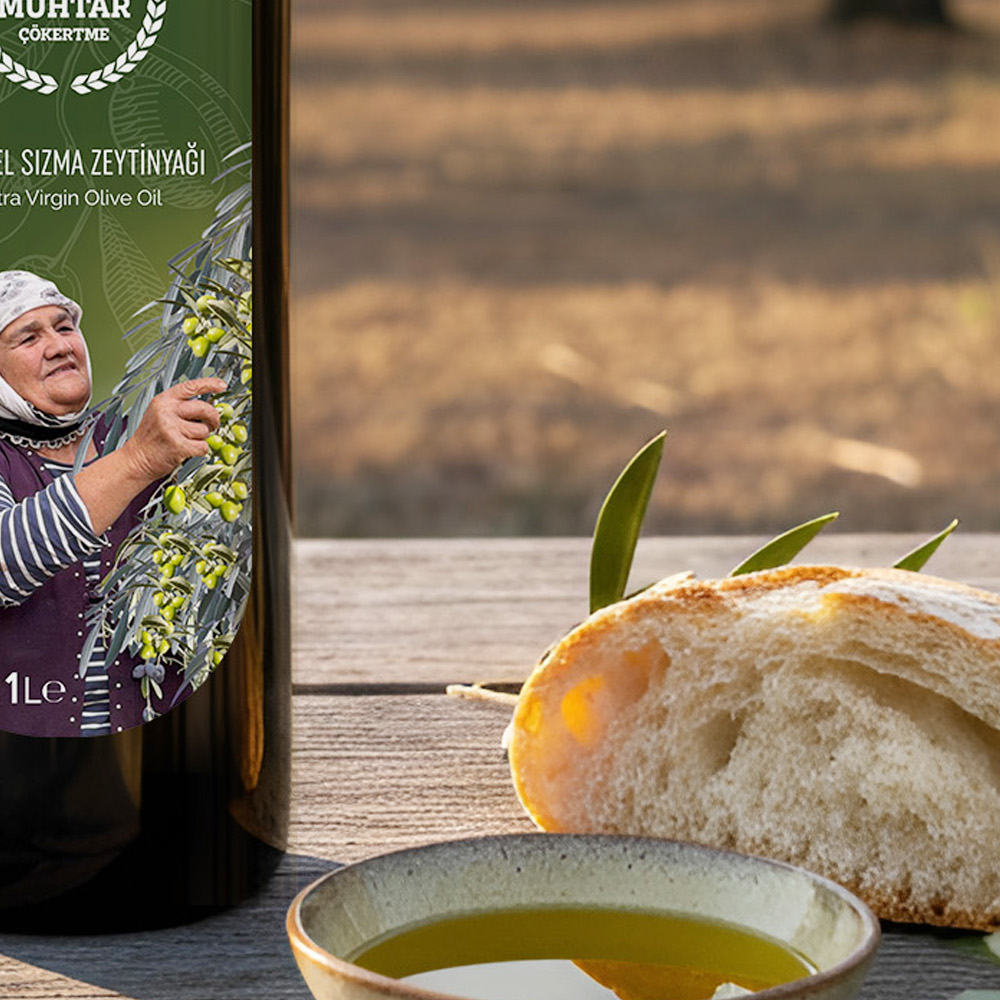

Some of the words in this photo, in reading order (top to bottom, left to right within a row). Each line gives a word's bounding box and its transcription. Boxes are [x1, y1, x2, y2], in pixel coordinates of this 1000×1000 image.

[19, 24, 109, 44] ÇÖKERTME
[22, 149, 84, 175] SIZMA
[91, 142, 204, 175] ZEYTİNYAĞI
[26, 190, 78, 210] Virgin
[85, 190, 132, 205] Olive
[137, 189, 162, 205] Oil
